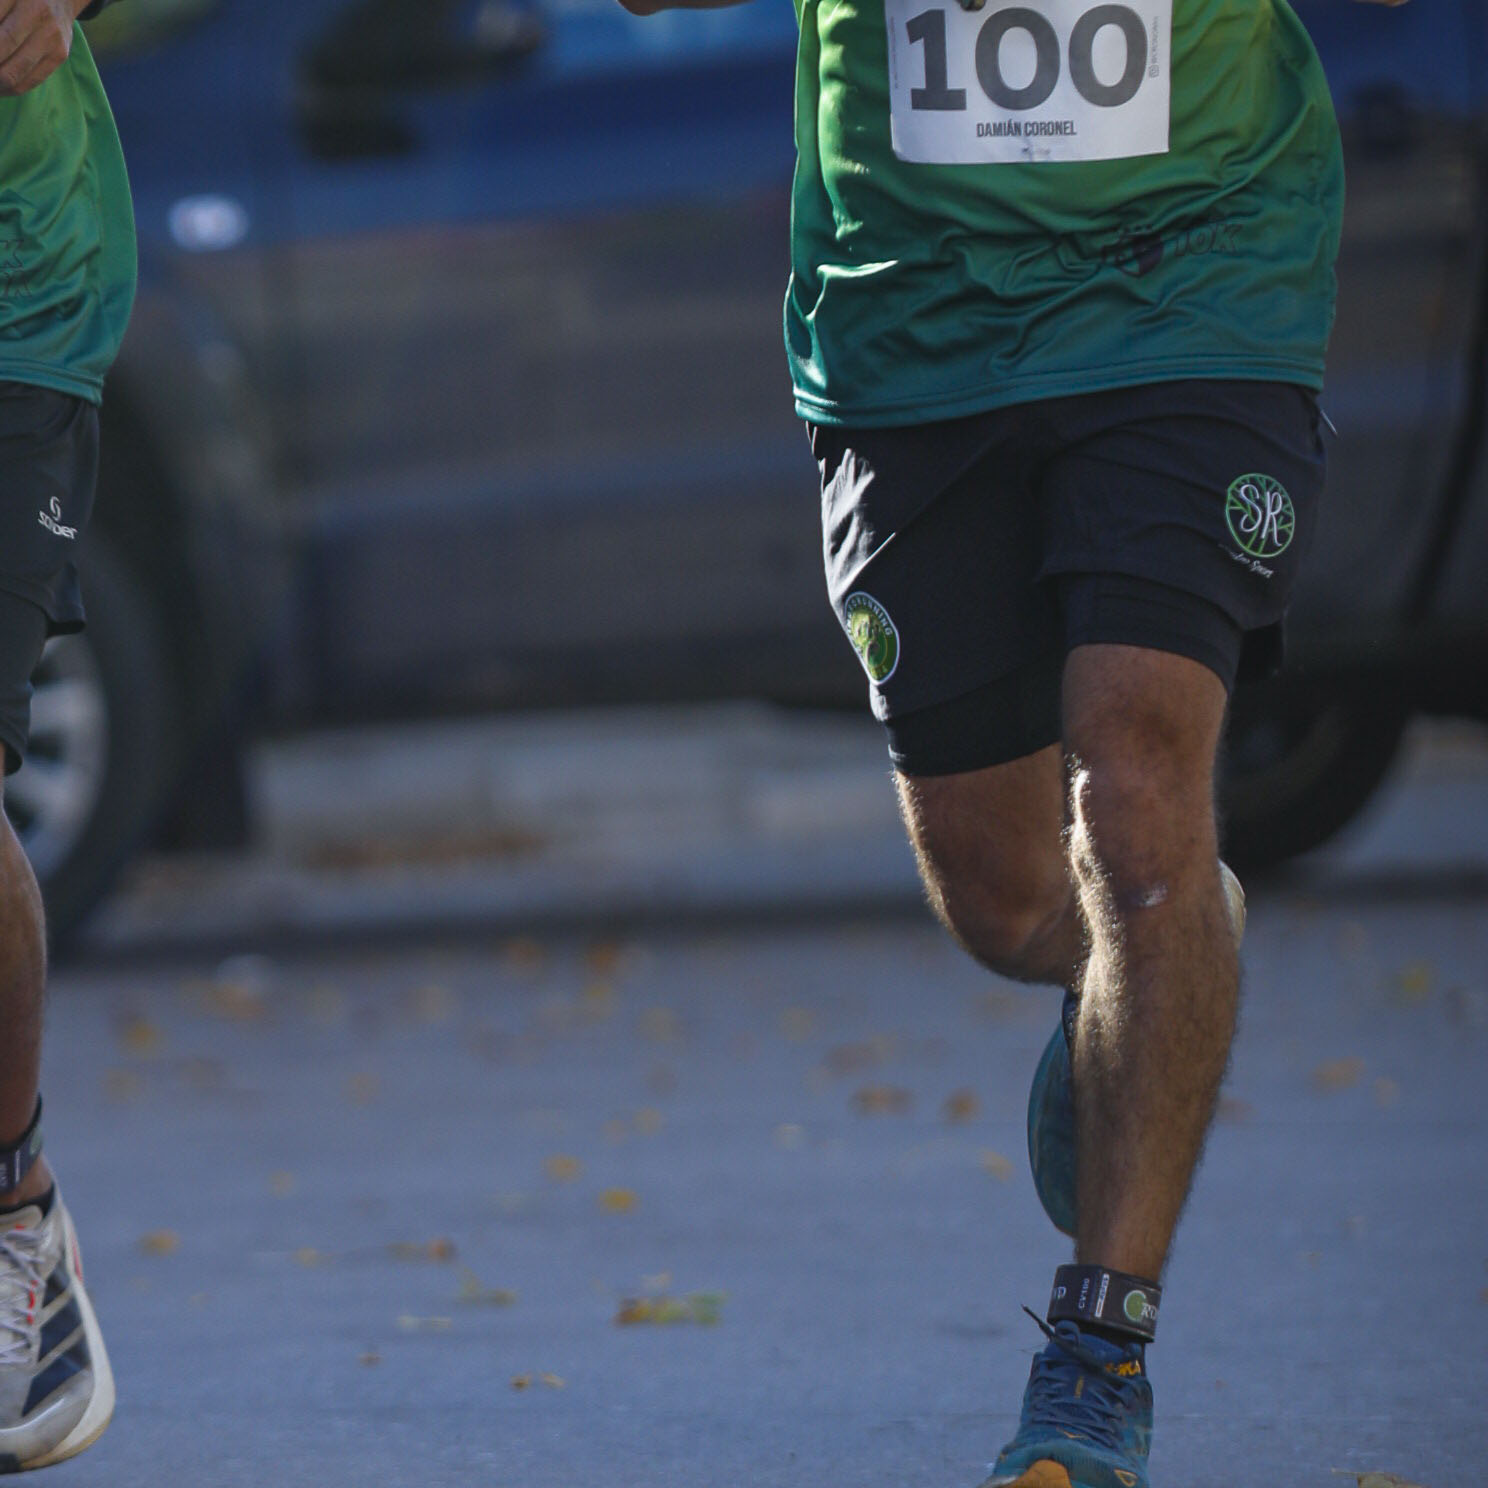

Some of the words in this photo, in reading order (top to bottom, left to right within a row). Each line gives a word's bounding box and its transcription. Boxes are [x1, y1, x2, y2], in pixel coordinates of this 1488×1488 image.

[906, 3, 1148, 111] 100
[976, 119, 1022, 138] DAMIÁN
[1024, 120, 1077, 137] CORONEL
[1240, 484, 1283, 548] SR
